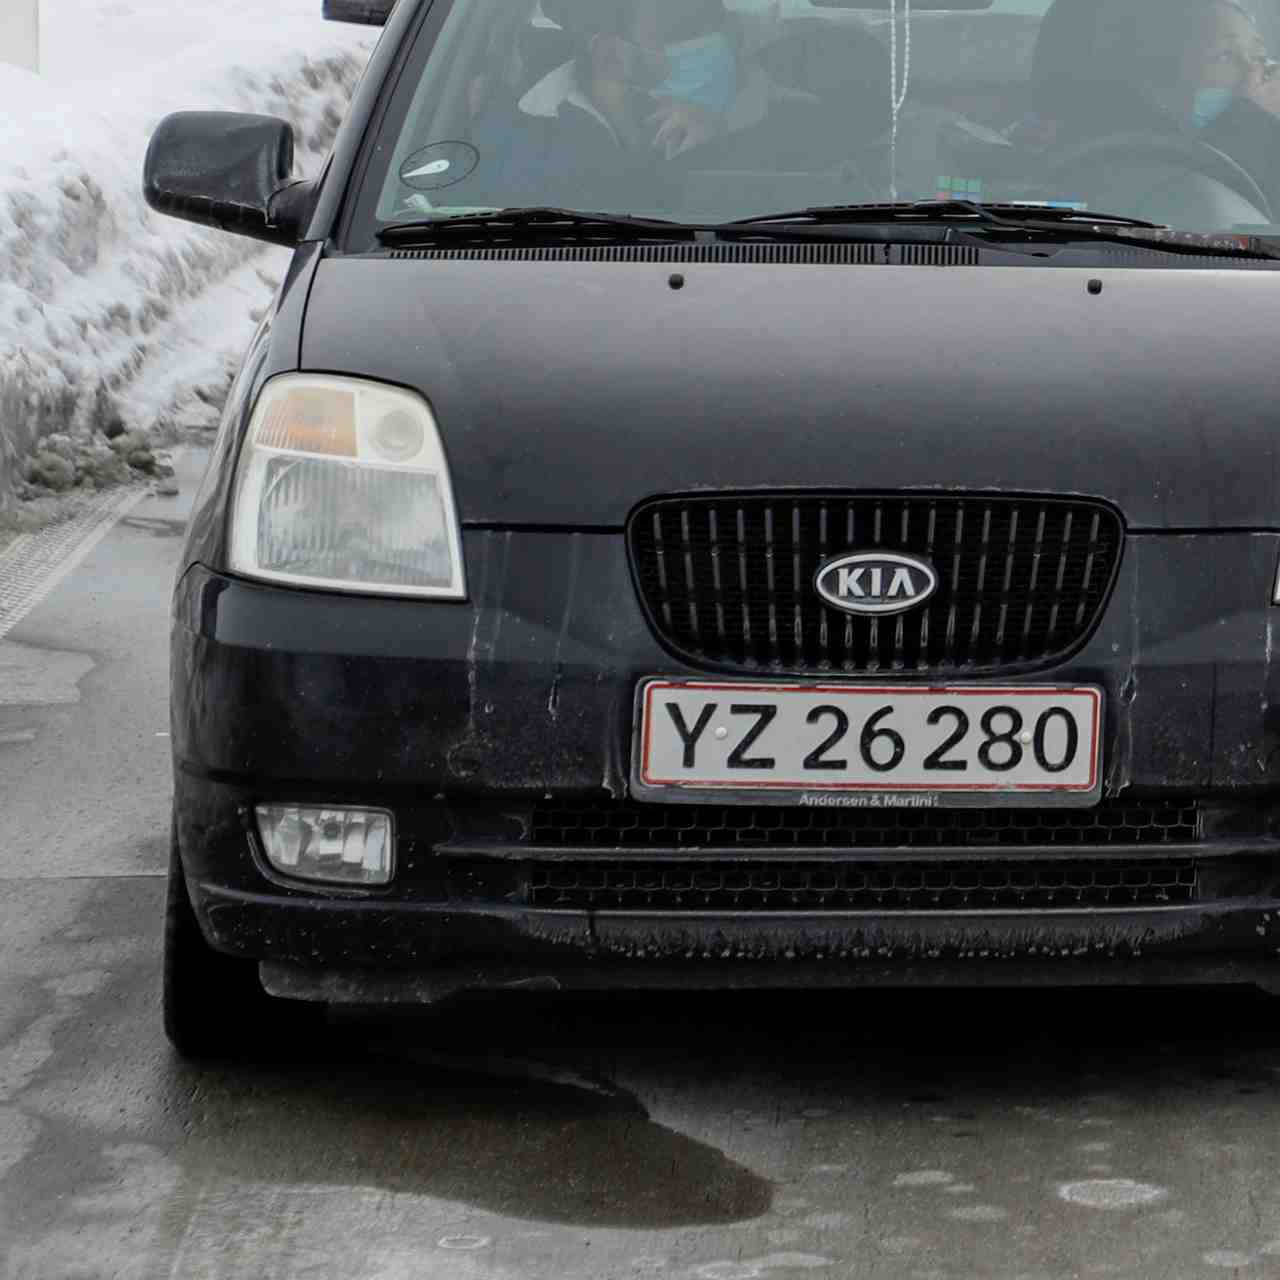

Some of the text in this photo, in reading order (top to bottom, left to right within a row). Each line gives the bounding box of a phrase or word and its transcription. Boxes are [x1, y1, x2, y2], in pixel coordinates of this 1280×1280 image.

[837, 567, 916, 598] KIA
[665, 702, 778, 769] YZ
[869, 794, 881, 807] &
